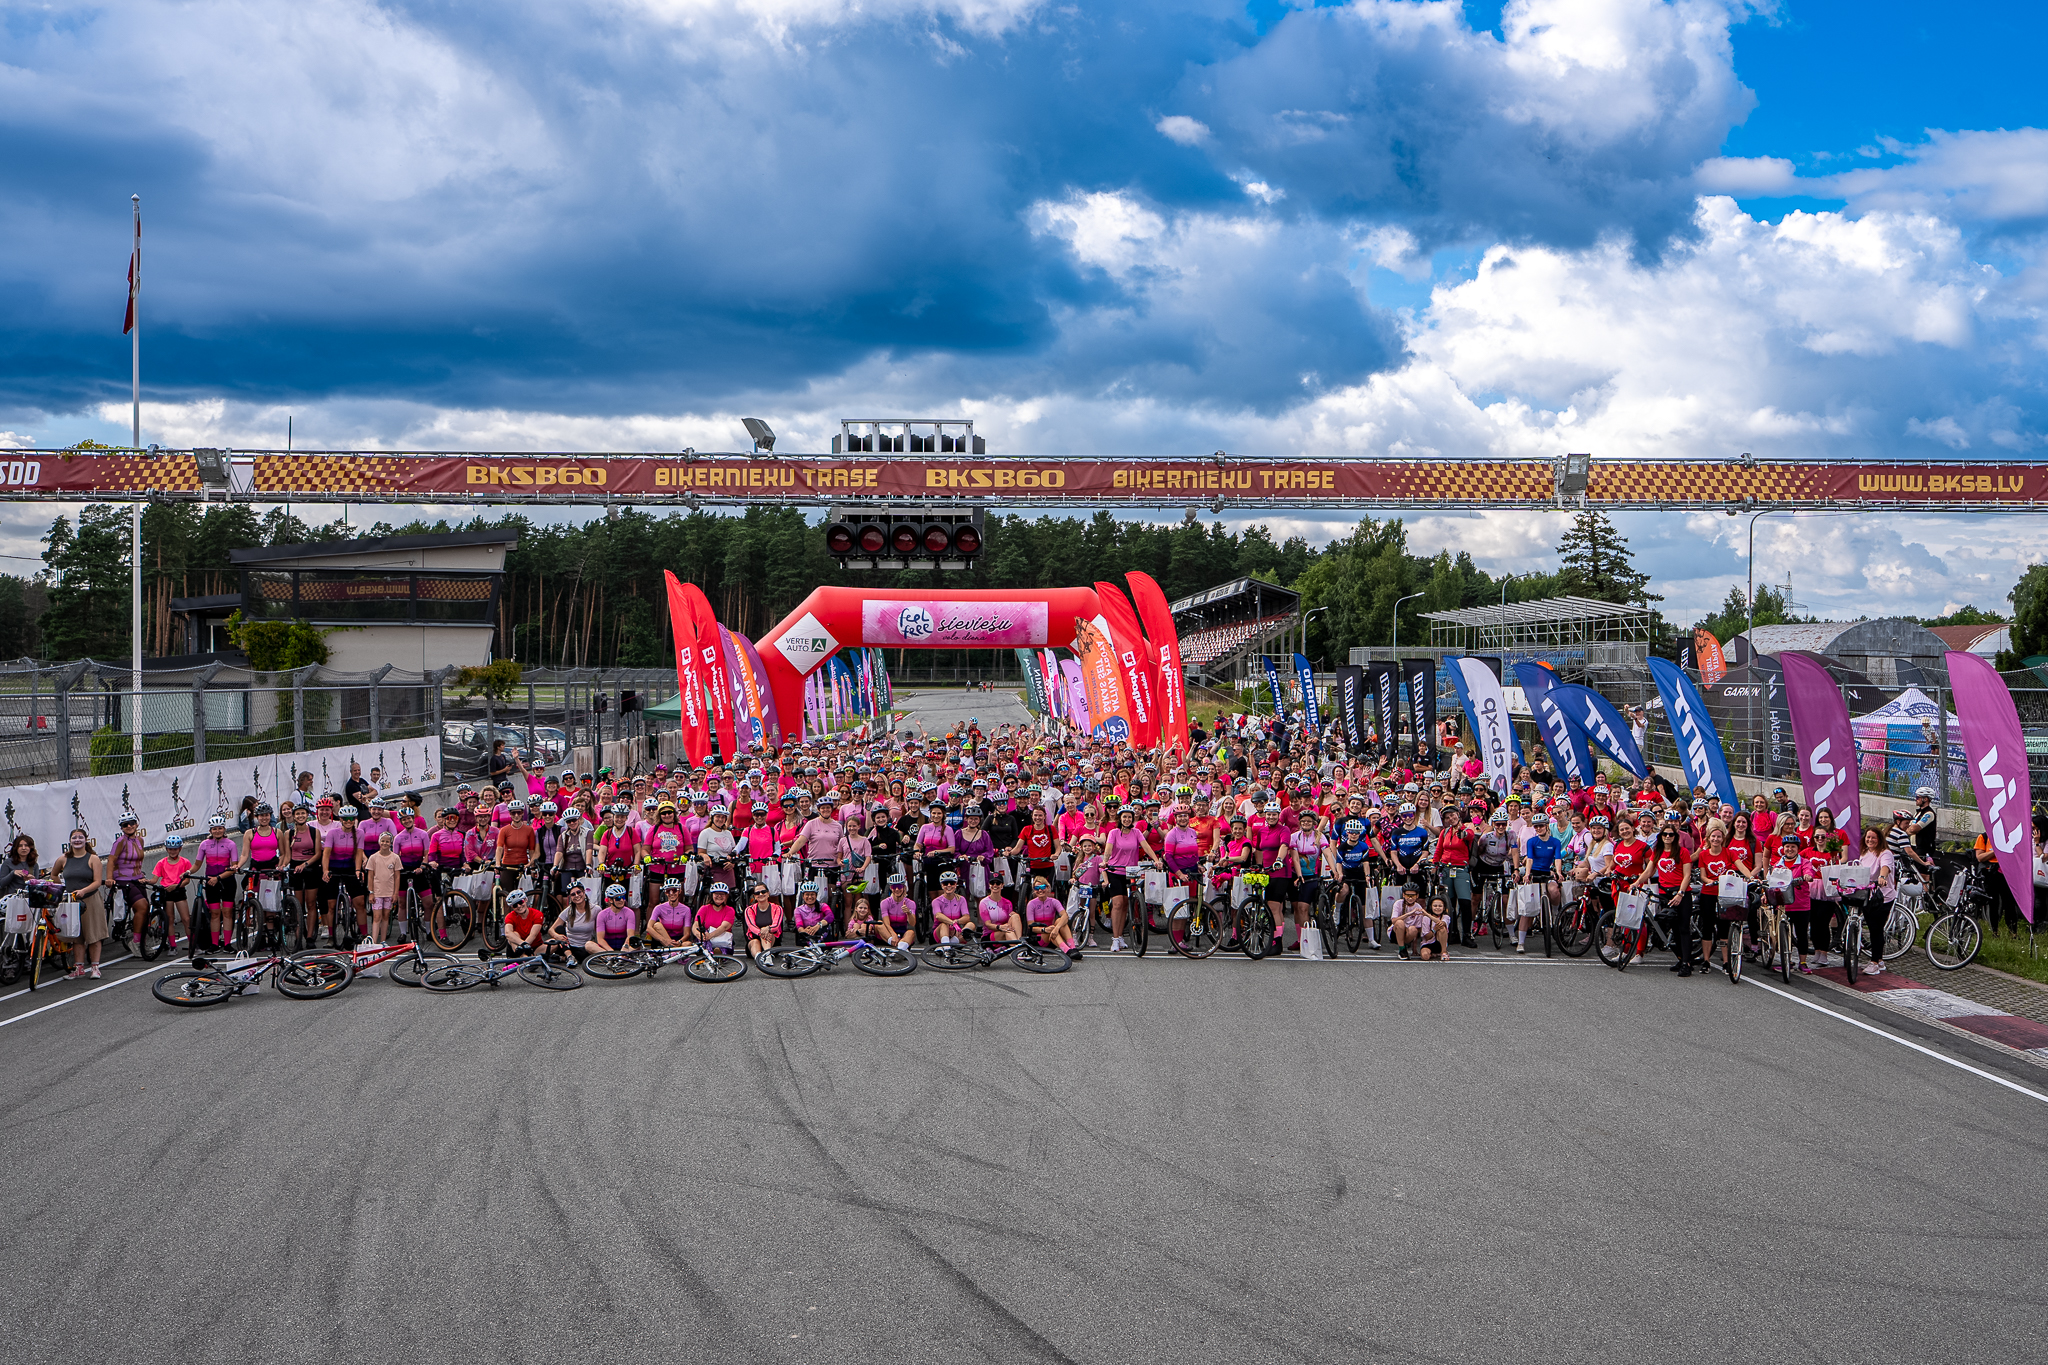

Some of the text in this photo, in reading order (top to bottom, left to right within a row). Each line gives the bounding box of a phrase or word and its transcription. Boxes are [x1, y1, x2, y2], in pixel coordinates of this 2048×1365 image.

[466, 465, 607, 486] BKSB60
[803, 468, 878, 487] TRASE
[926, 469, 1065, 488] BKSB60
[1260, 470, 1335, 489] TRASE
[1858, 474, 2024, 493] WWW.BKSB.LV
[937, 615, 1013, 633] sieviešu
[785, 637, 810, 645] VERTE
[786, 644, 810, 652] AUTO
